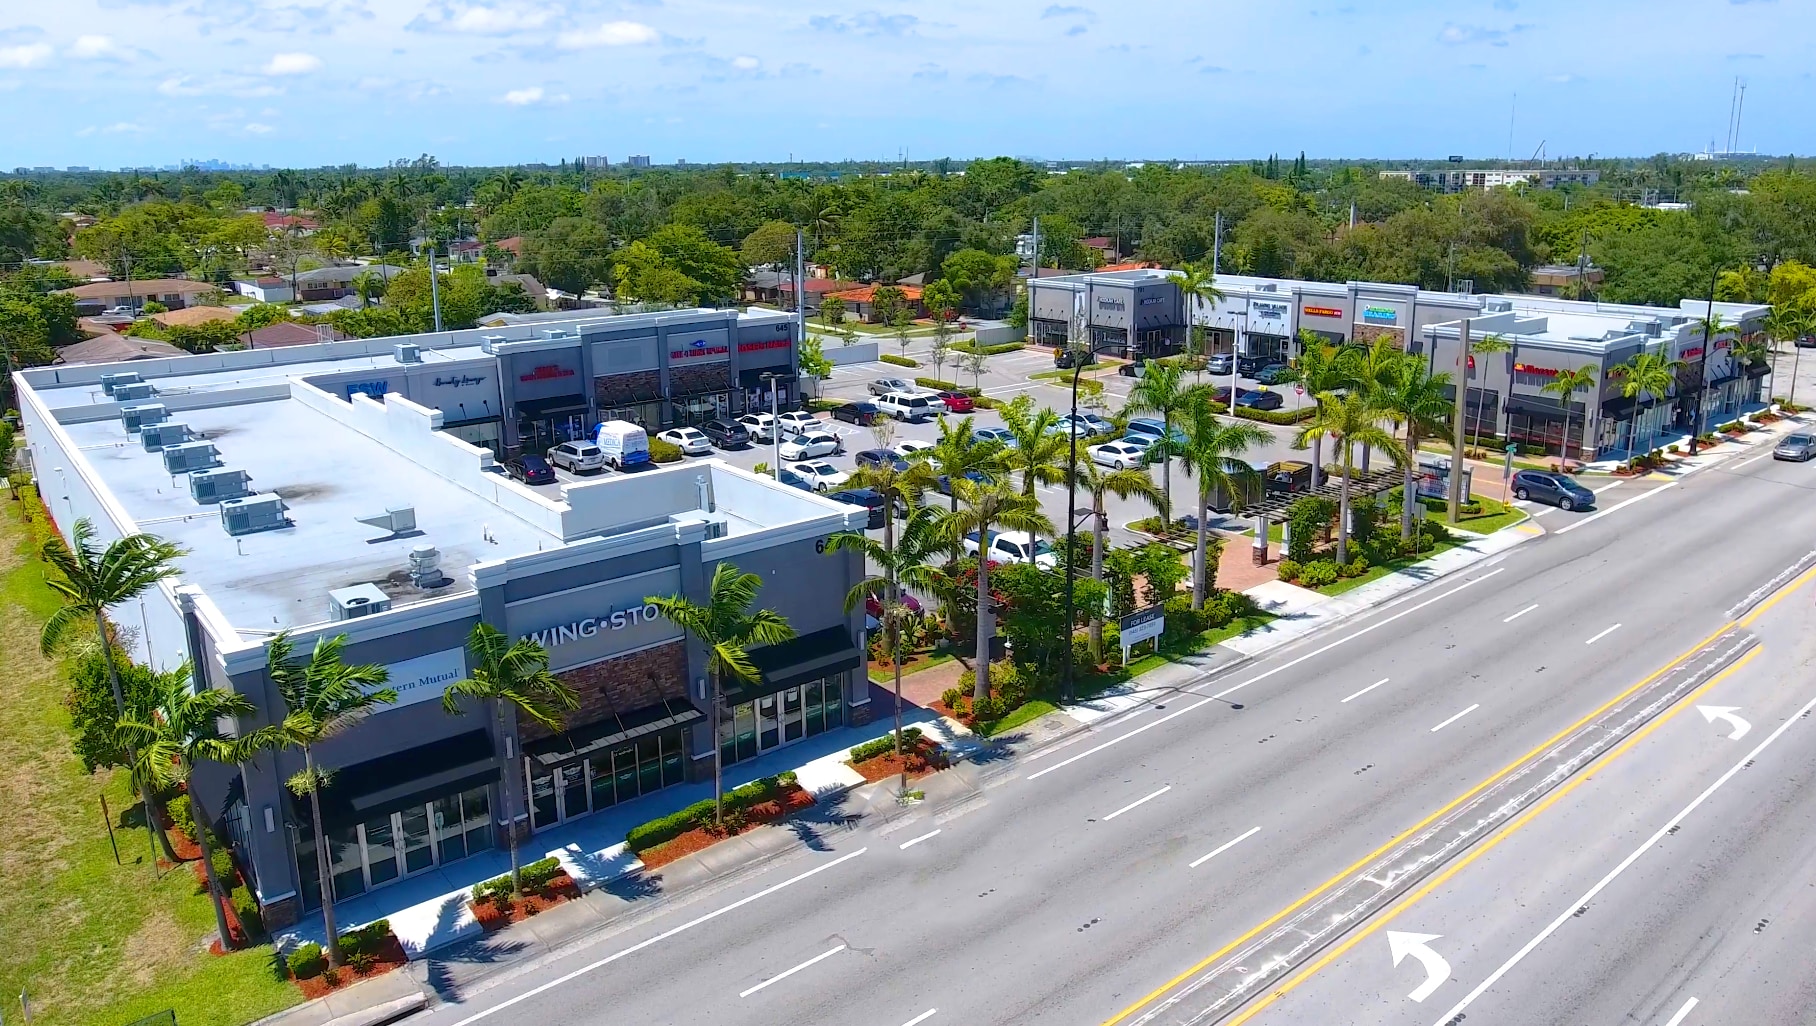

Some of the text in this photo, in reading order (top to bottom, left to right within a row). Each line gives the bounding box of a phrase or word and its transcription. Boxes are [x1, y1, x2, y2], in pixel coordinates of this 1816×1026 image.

[775, 324, 788, 332] 645
[1130, 618, 1141, 627] FOR
[1140, 613, 1156, 623] LEASE
[418, 668, 458, 686] Mutual
